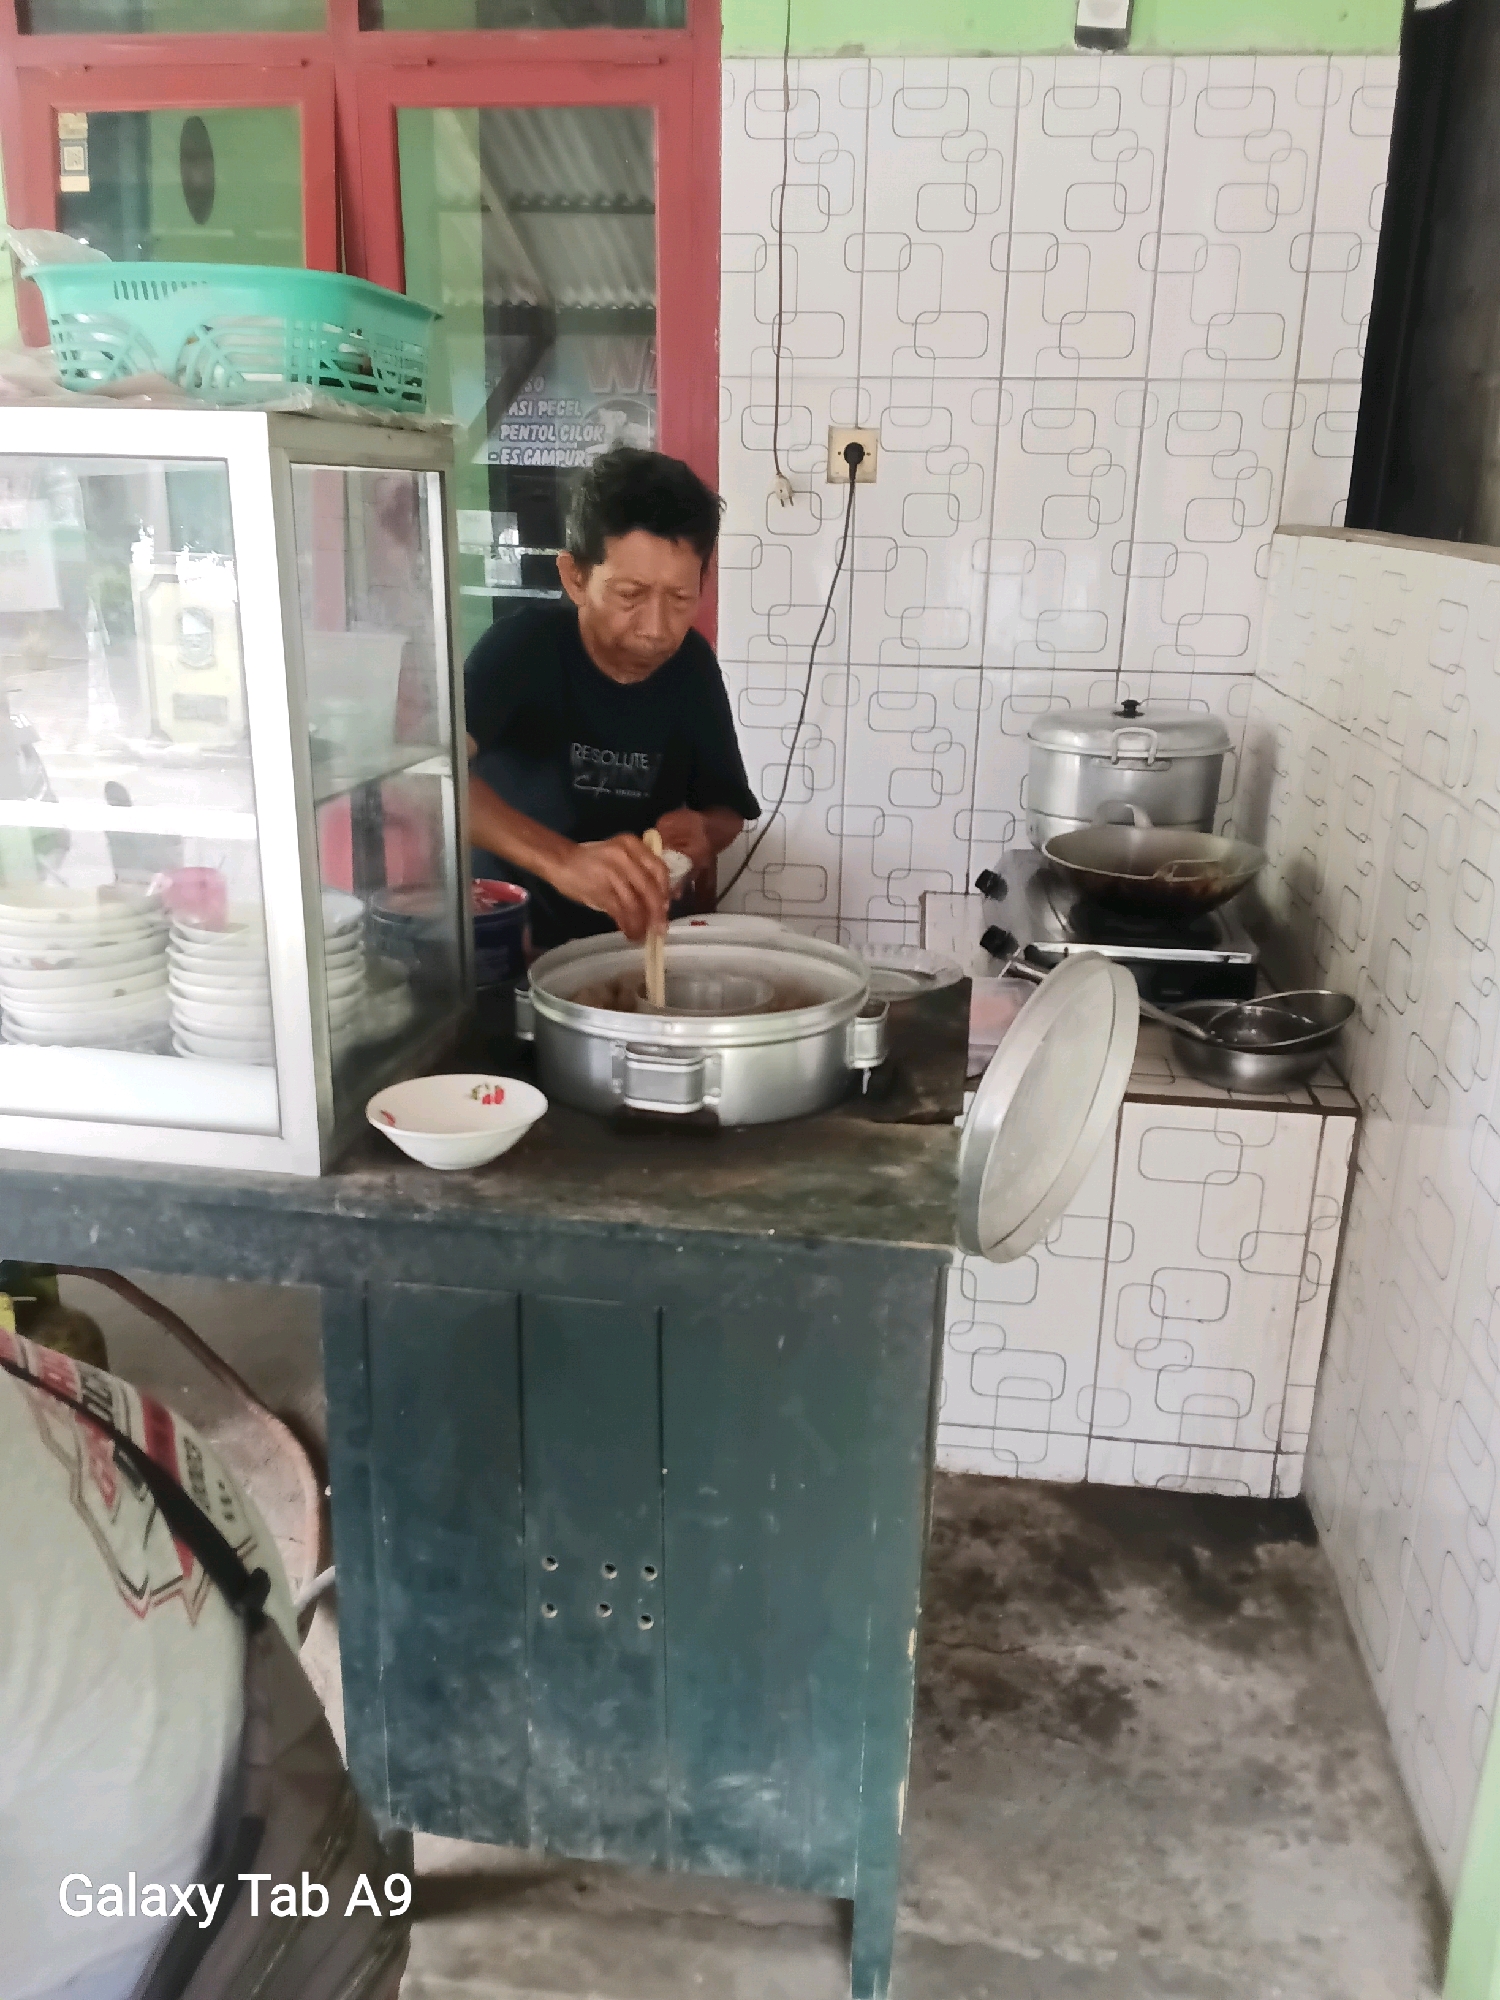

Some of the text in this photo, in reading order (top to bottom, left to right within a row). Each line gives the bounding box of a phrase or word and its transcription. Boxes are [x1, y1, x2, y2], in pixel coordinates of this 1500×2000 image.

[507, 400, 582, 416] ASI PECEL
[500, 424, 604, 442] PENTOL CILOK
[500, 448, 520, 465] ES
